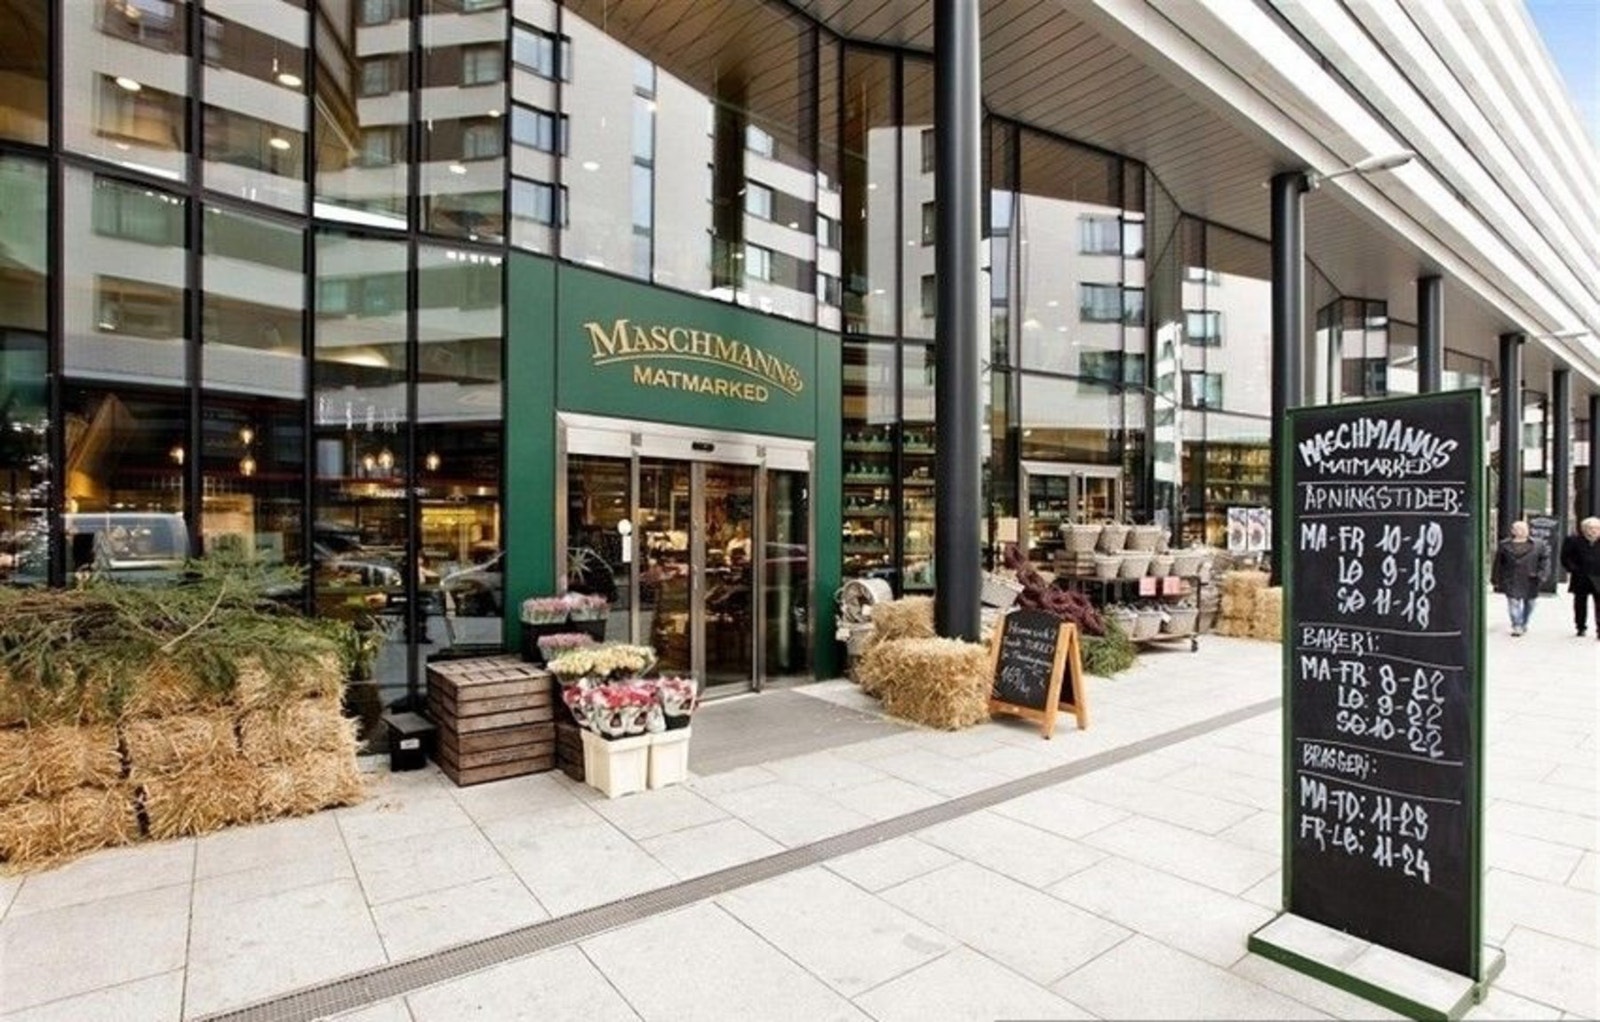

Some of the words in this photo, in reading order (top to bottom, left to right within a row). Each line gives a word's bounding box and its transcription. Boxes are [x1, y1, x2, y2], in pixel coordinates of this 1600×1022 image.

[584, 318, 803, 392] MASCHMANNS
[633, 364, 769, 403] MATMARKED
[1319, 453, 1432, 478] MATMARKED
